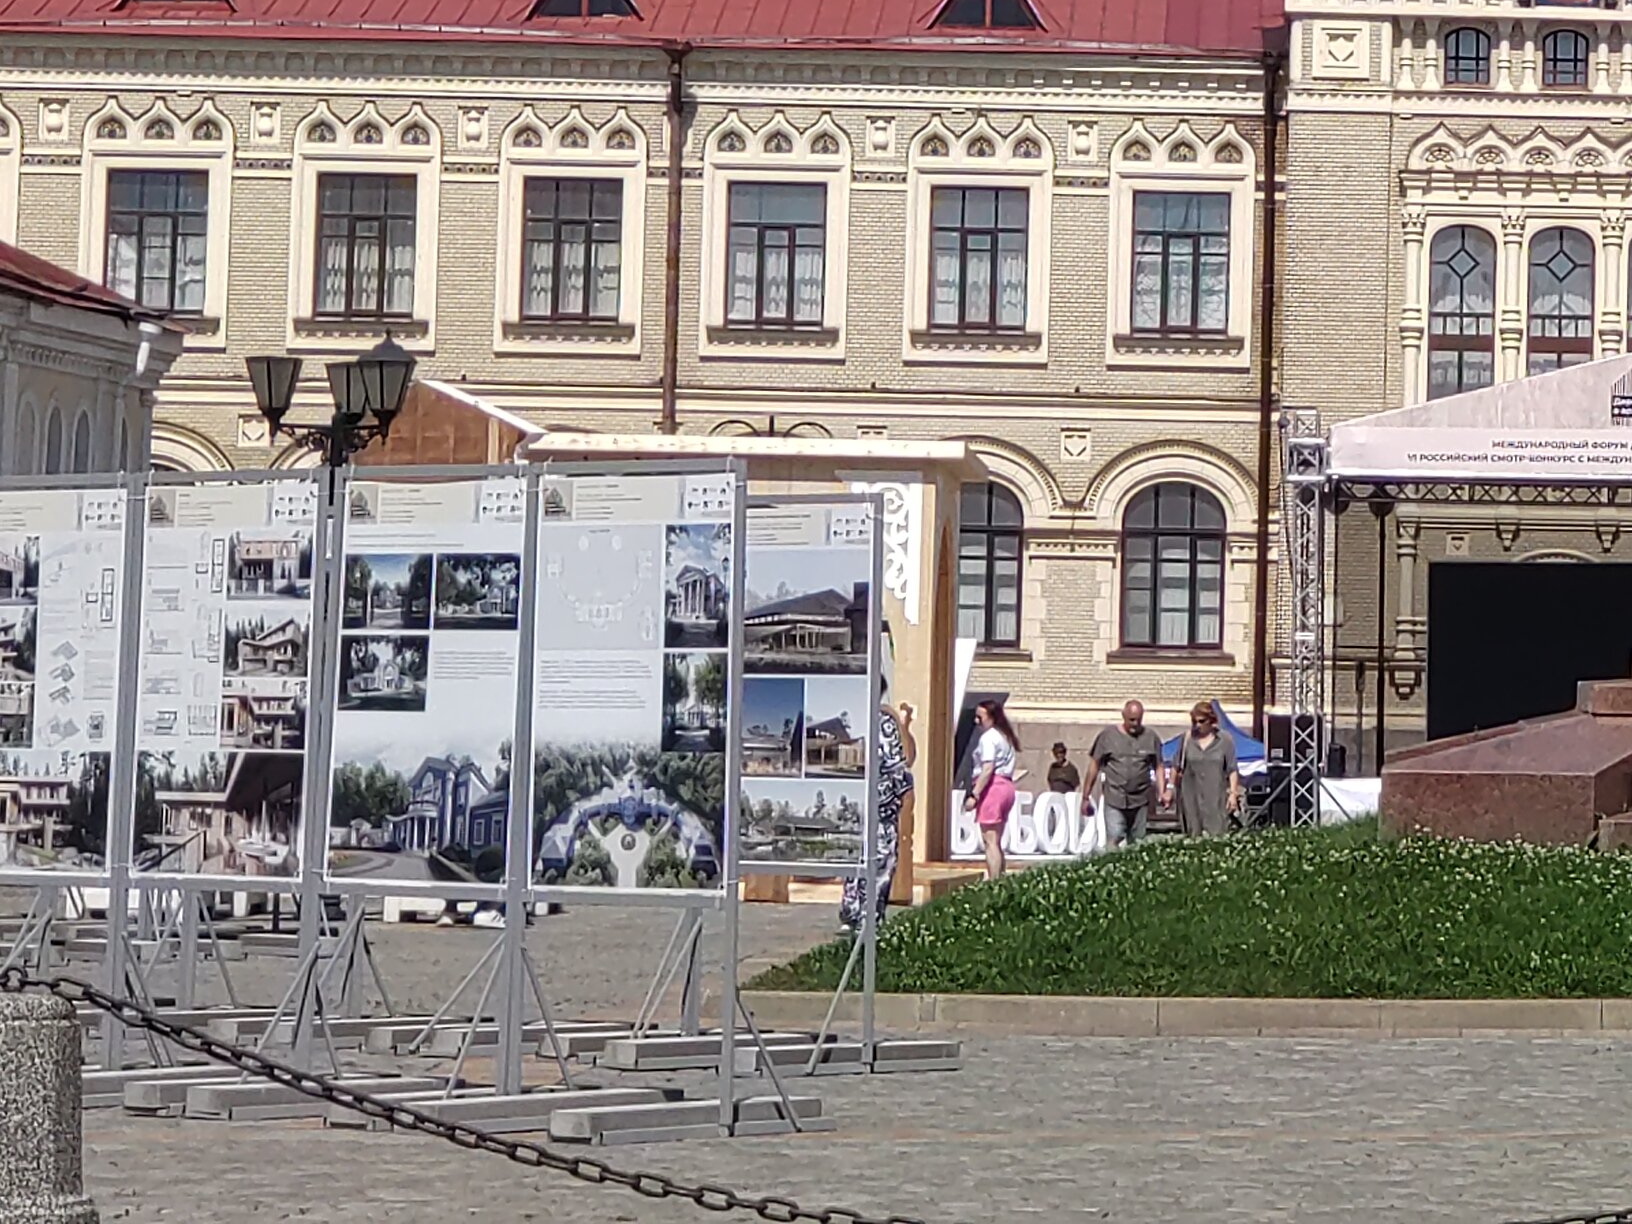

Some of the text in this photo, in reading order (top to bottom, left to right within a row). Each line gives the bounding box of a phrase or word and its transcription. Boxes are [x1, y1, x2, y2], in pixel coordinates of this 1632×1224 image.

[1492, 440, 1588, 449] МЕЖДУНАРОДНЫЙ
[1591, 442, 1628, 450] ФОРУМ
[1420, 453, 1488, 463] РОССИЙСКИЙ
[1491, 454, 1575, 464] СМОТР-КОНКУРС
